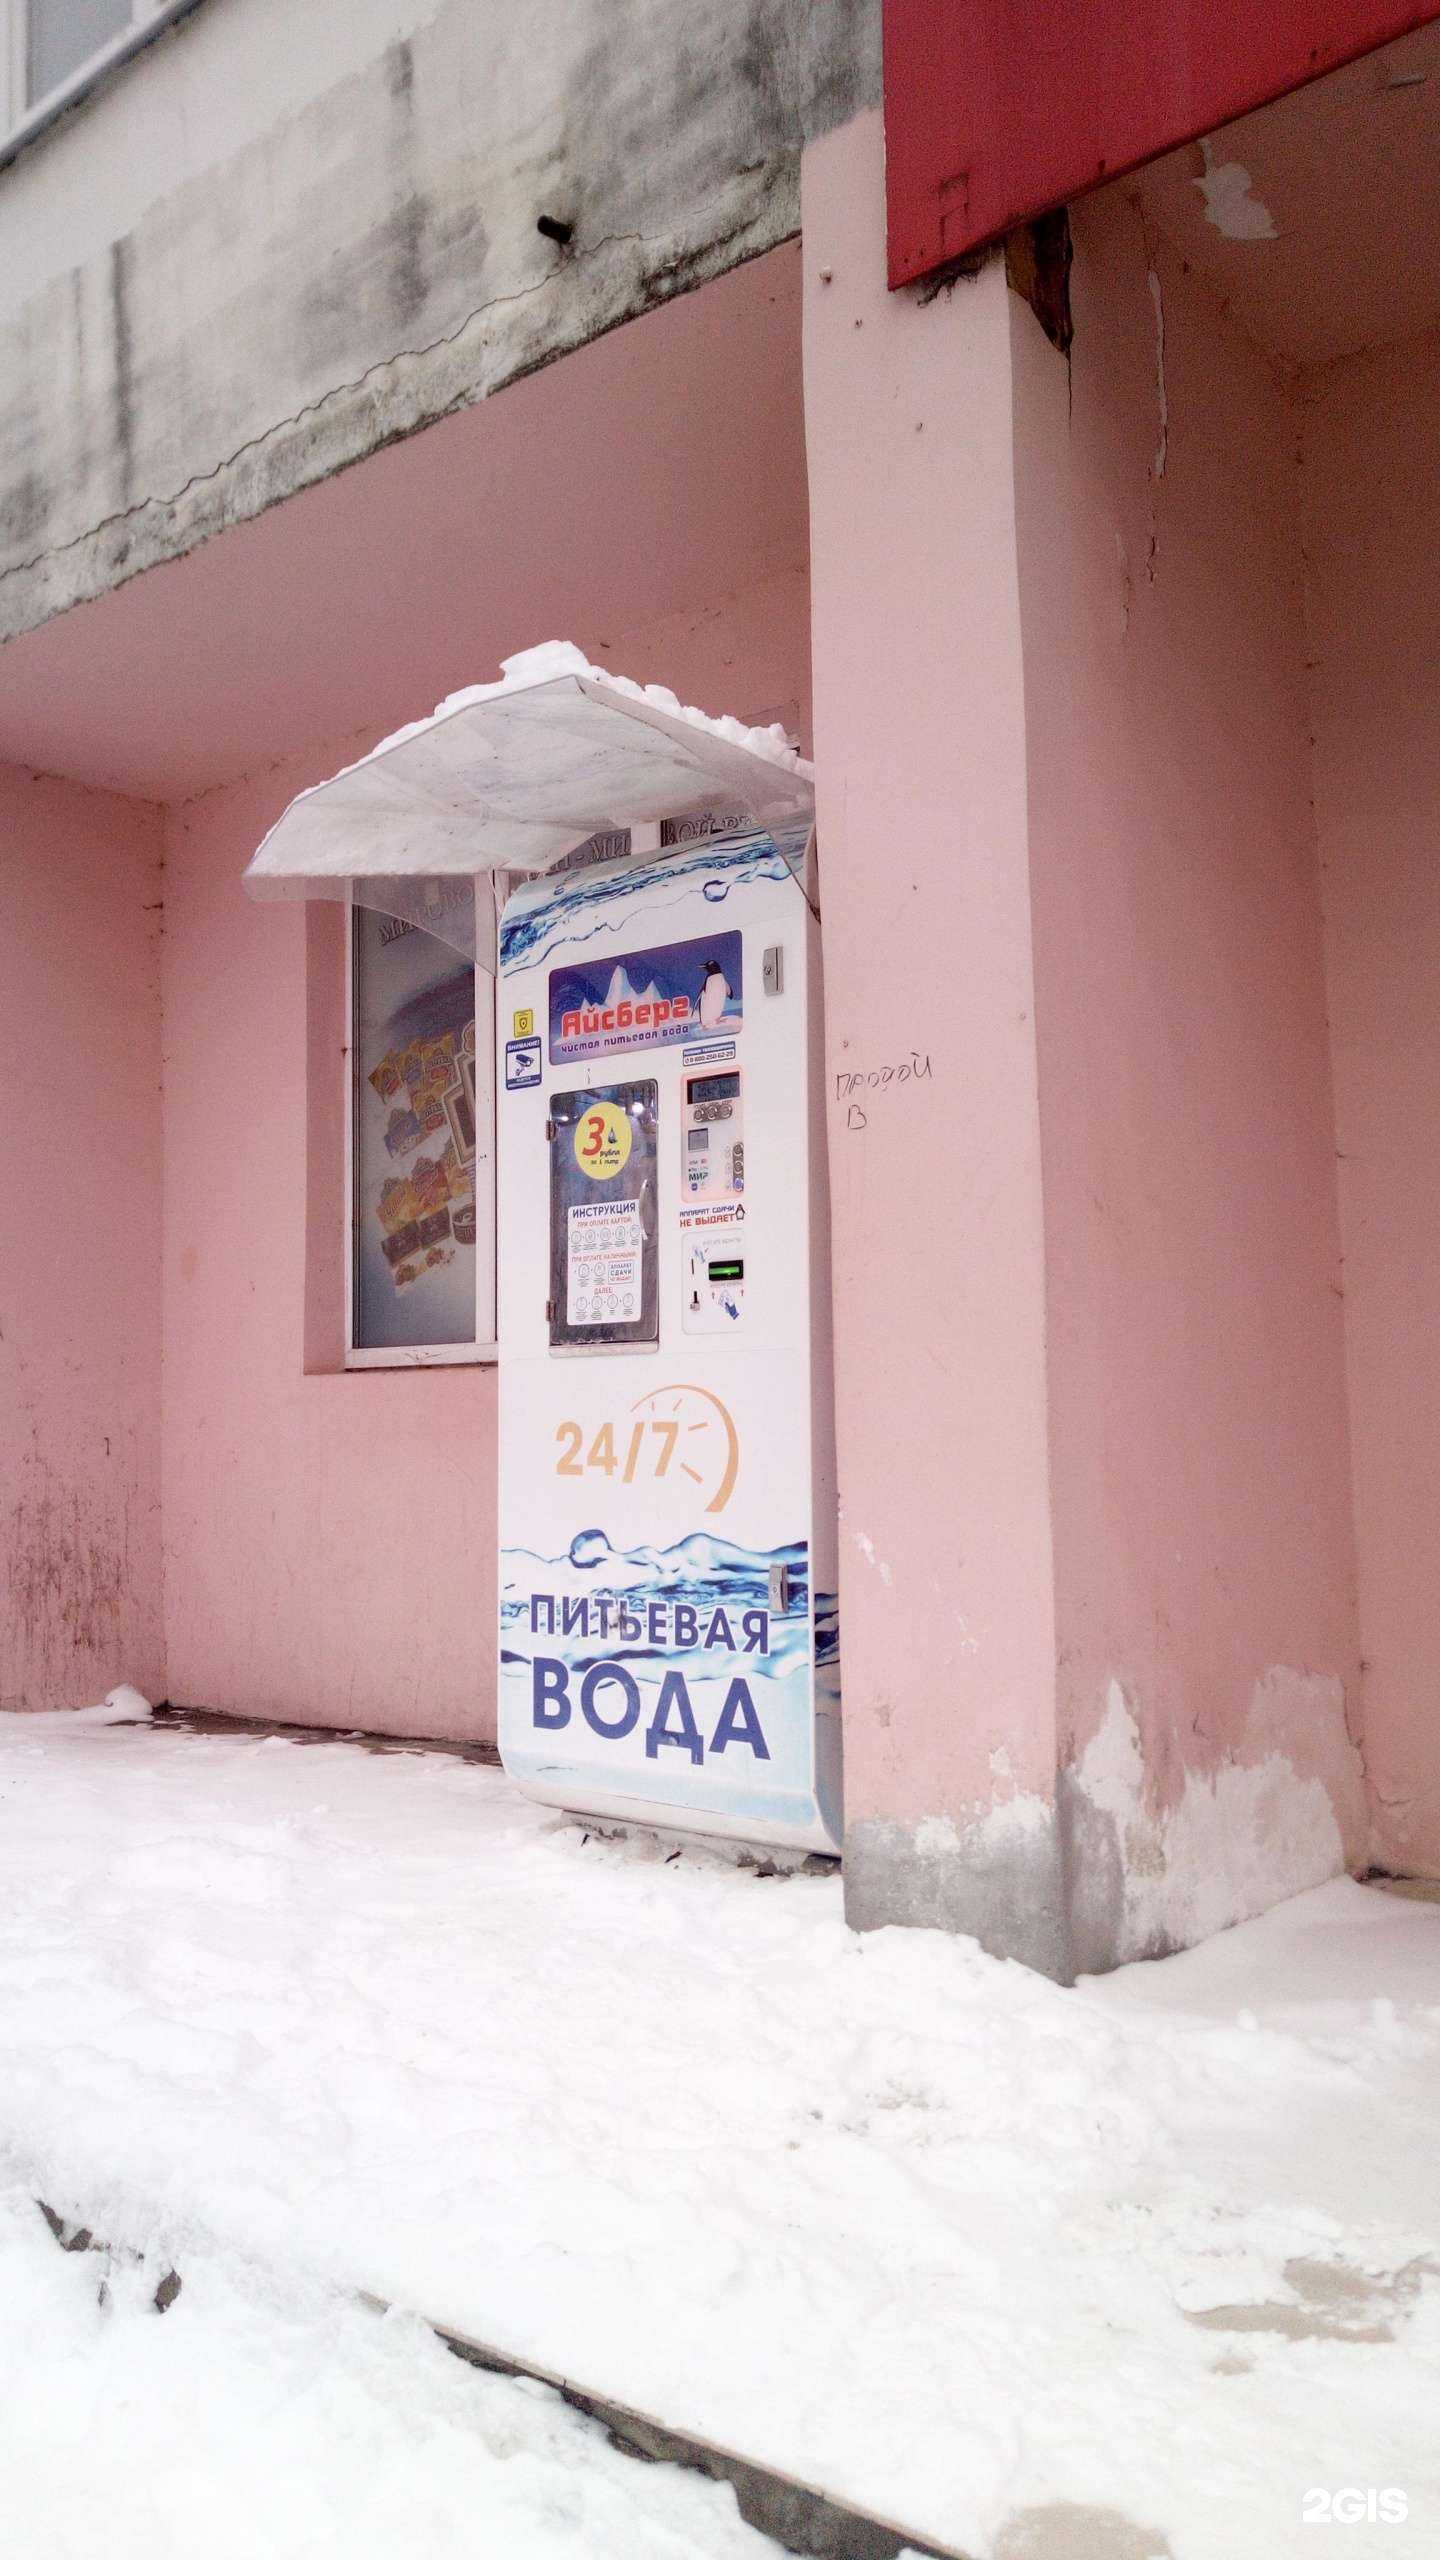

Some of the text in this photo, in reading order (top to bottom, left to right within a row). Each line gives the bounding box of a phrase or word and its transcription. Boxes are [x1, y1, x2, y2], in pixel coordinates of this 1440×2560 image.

[562, 996, 690, 1037] Айсберг
[561, 1026, 689, 1053] чистая питьевая вода
[582, 1116, 605, 1156] 3
[573, 1203, 636, 1218] ИНСТРУКЦИЯ
[680, 1219, 692, 1228] НЕ
[555, 1421, 679, 1483] 24/7
[530, 1594, 769, 1654] ПИТЬЕВАЯ
[532, 1656, 771, 1765] ВОДА
